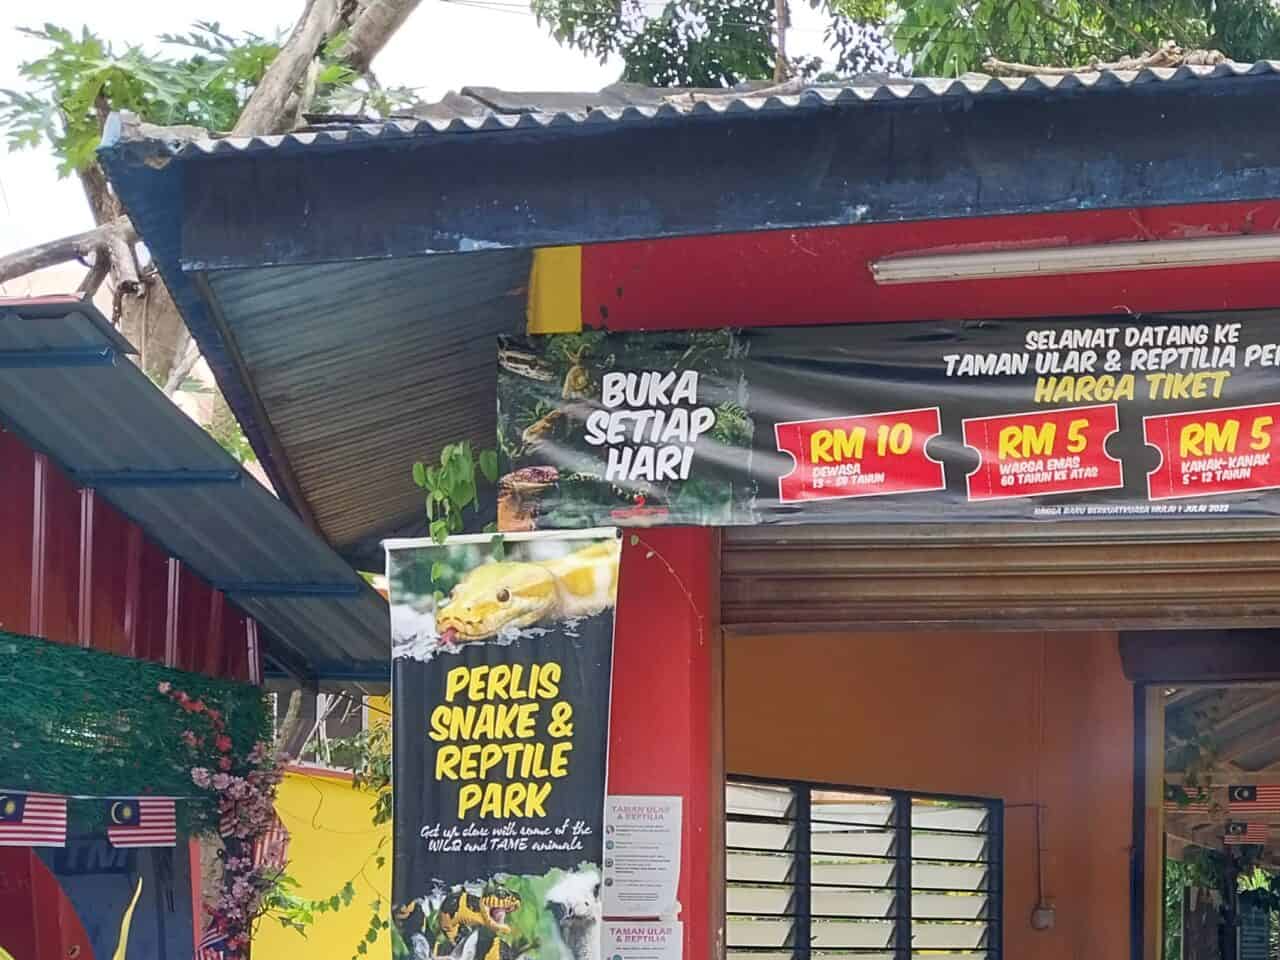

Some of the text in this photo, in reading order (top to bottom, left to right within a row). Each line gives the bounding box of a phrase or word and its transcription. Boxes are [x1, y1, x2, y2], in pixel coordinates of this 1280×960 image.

[1024, 322, 1241, 351] SELAMAT DATANG KE
[943, 353, 1029, 377] TAMAN
[1035, 350, 1098, 374] ULAR
[1103, 349, 1122, 373] &
[1129, 345, 1237, 372] REPTILIA
[602, 370, 699, 408] BUKA
[1033, 370, 1231, 403] HARGA TIKET
[584, 407, 716, 445] SETIAP
[810, 422, 913, 464] RM 10
[998, 419, 1089, 460] RM 5
[1179, 415, 1274, 459] RM 5
[605, 445, 695, 481] HARI
[812, 463, 861, 477] DEWASA
[999, 455, 1081, 475] WARGA EMAS
[1018, 470, 1053, 485] TAHUN
[1070, 466, 1099, 480] ATAS
[1181, 453, 1271, 475] KANAK-KANAK
[1214, 467, 1252, 482] TAHUN
[445, 662, 562, 702] PERLIS
[429, 701, 574, 741] SNAKE &
[435, 742, 573, 780] REPTILE
[458, 782, 552, 819] PARK
[420, 818, 593, 842] Get up close with some of the
[464, 838, 487, 851] and
[490, 838, 529, 851] TAME
